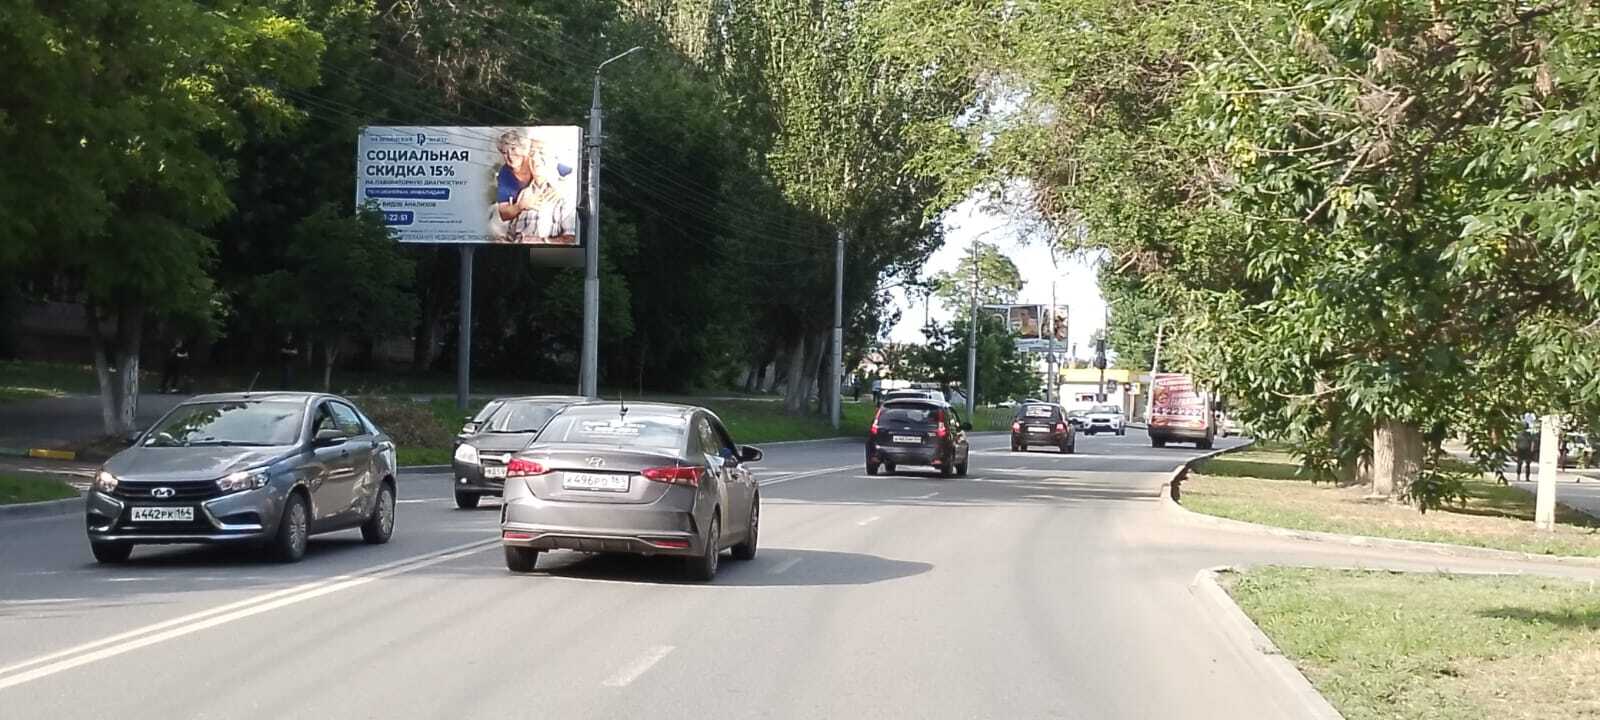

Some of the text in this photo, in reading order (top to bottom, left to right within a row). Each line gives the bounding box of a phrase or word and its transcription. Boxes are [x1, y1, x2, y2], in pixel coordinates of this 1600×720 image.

[366, 150, 469, 162] СОЦИАЛЬНАЯ
[366, 165, 455, 178] СКИДКА 15%
